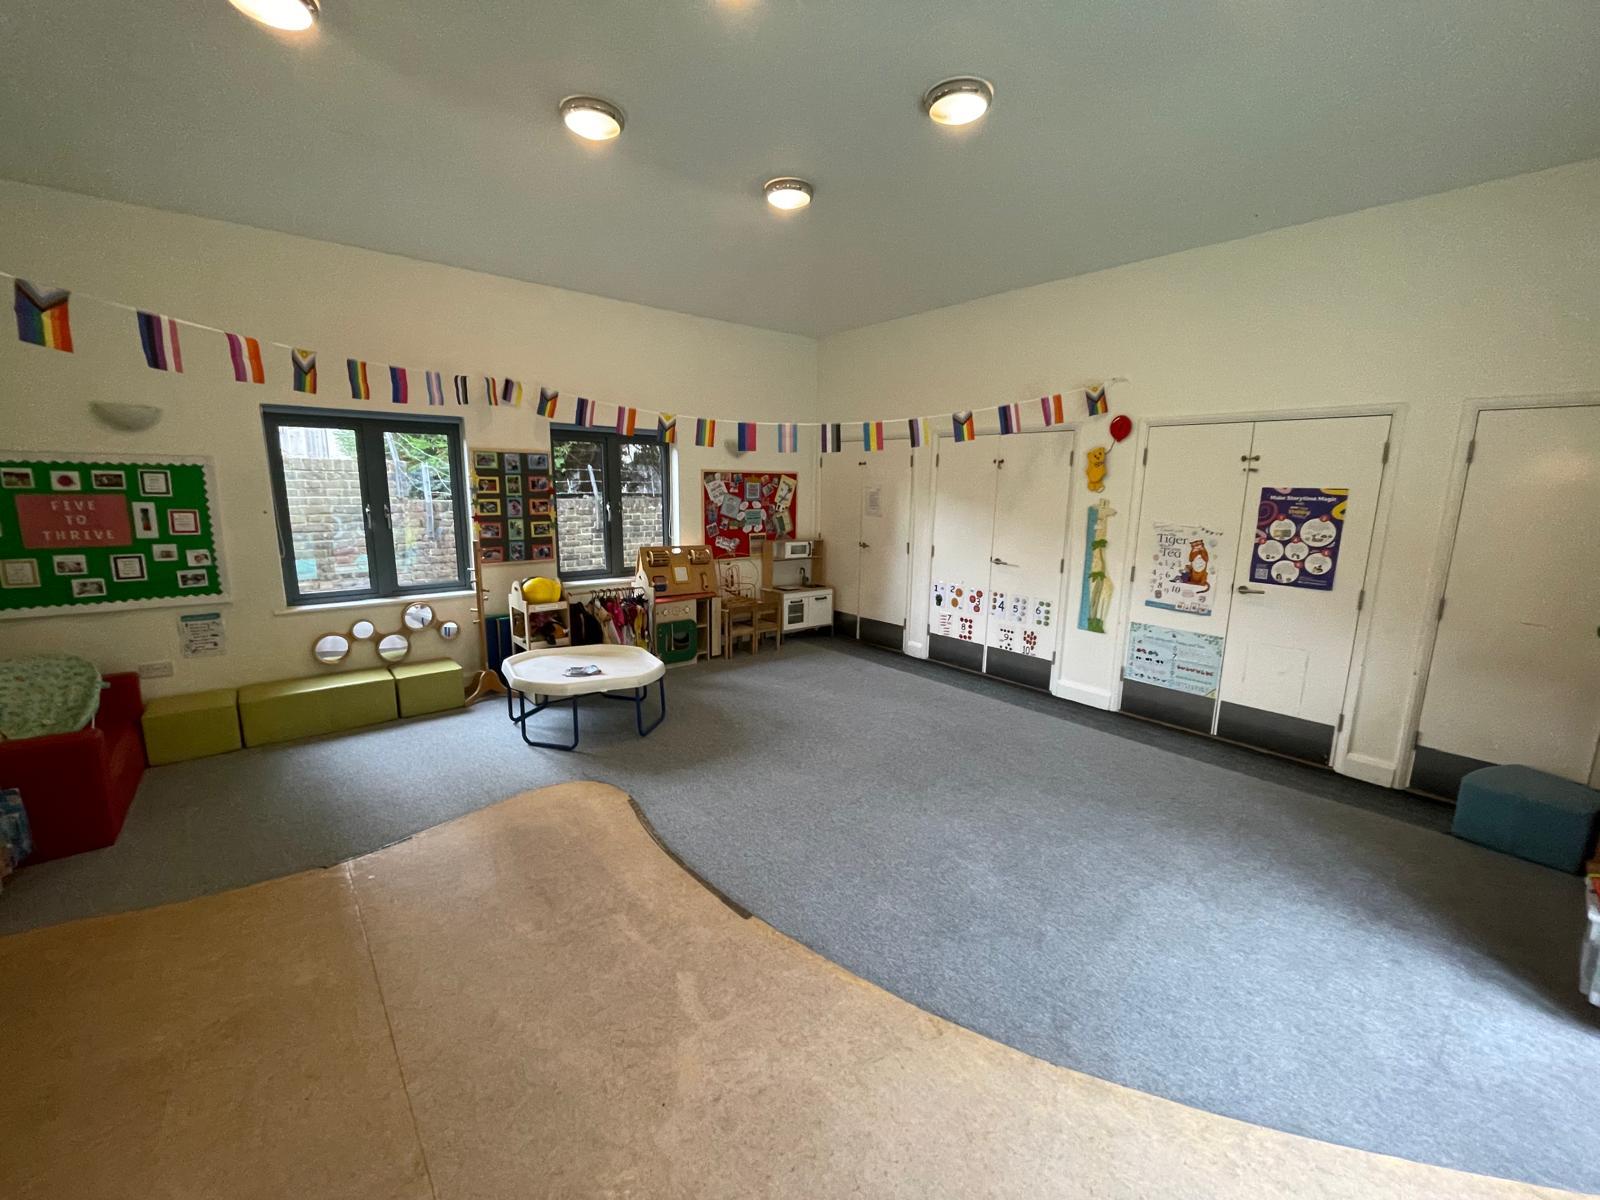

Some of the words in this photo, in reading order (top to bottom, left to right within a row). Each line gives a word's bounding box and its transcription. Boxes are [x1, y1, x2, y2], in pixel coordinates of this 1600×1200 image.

[50, 500, 96, 511] FIVE
[64, 515, 87, 525] TO
[42, 529, 115, 541] THRIVE
[1156, 533, 1188, 545] Tiger
[1161, 548, 1182, 559] Tea
[934, 584, 939, 592] 1
[975, 598, 981, 606] 3
[998, 601, 1005, 612] 4
[1013, 605, 1019, 613] 5
[1036, 606, 1041, 615] 6
[1022, 646, 1031, 655] 10
